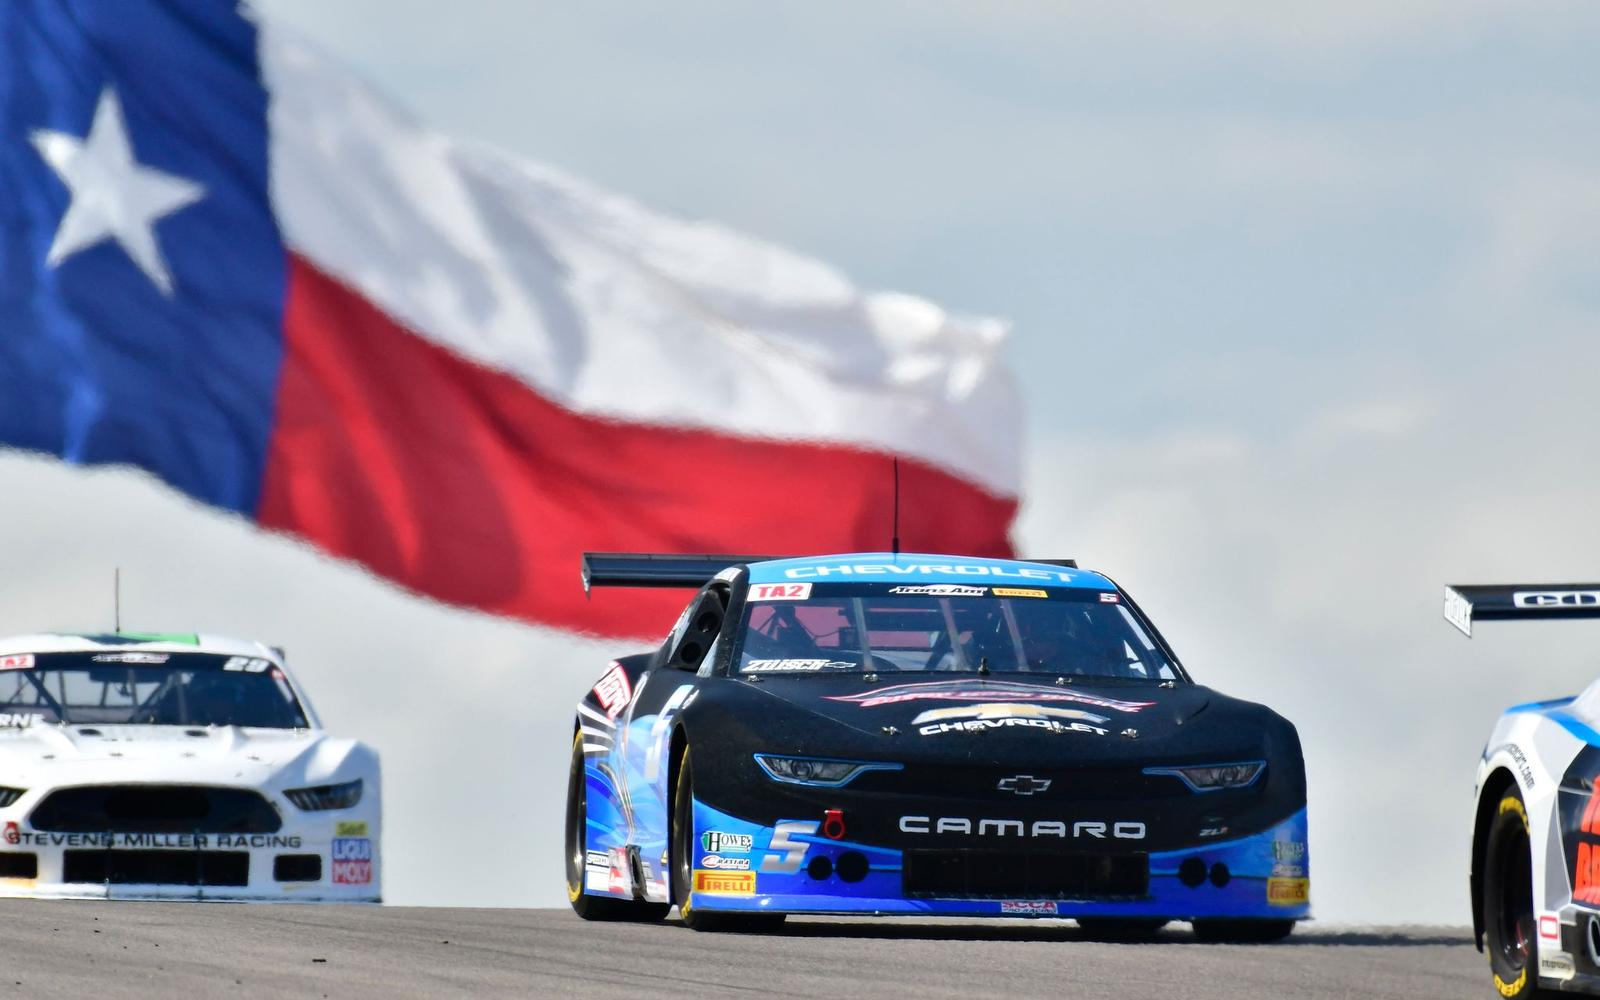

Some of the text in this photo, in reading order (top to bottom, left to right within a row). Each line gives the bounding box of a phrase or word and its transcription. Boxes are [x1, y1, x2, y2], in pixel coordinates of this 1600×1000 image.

[785, 564, 1077, 583] CHEVROLET
[756, 584, 804, 598] TA2
[0, 657, 29, 668] A2
[919, 717, 1109, 736] CHEVROLET
[899, 815, 1147, 839] CAMARO
[217, 834, 301, 849] RACING
[708, 832, 748, 852] HOWE
[760, 819, 821, 874] 5
[697, 873, 751, 892] PIRELLI
[1002, 901, 1055, 909] SCCA
